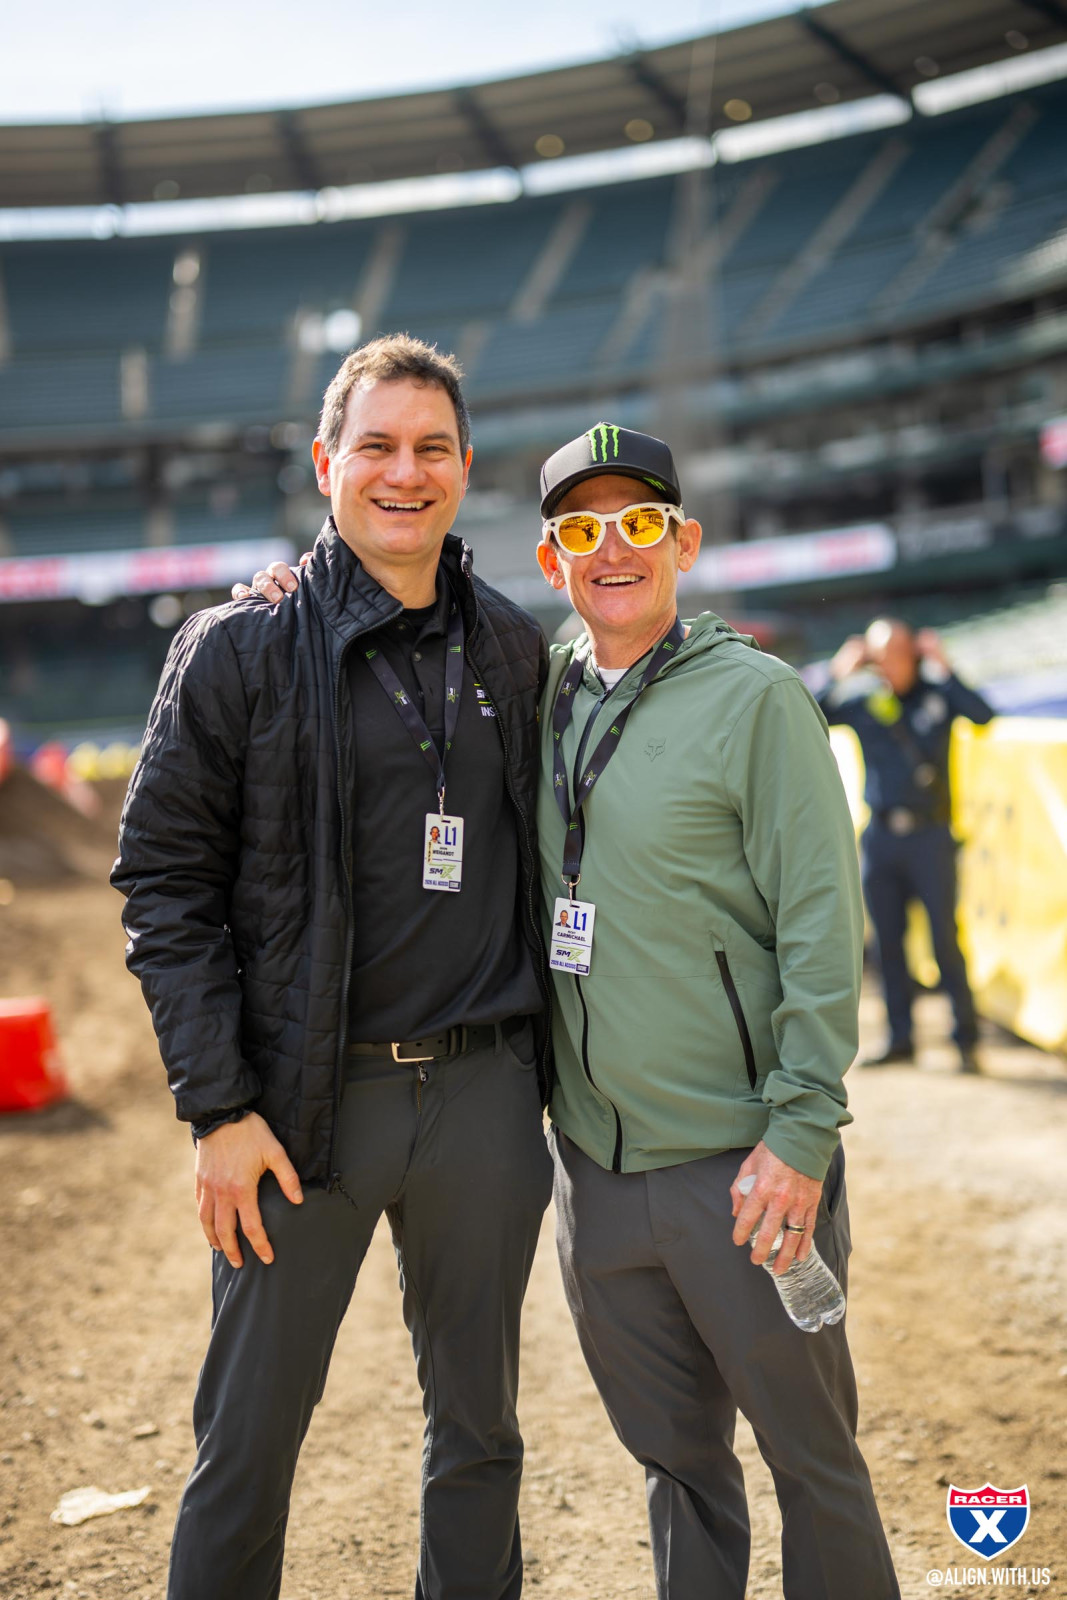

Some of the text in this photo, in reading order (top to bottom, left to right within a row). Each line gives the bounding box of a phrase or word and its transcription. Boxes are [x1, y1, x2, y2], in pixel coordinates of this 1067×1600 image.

[445, 826, 457, 846] L1
[429, 864, 456, 879] SMX
[573, 911, 587, 931] L1
[557, 932, 586, 941] CARMICHAEL
[556, 947, 585, 962] SMX
